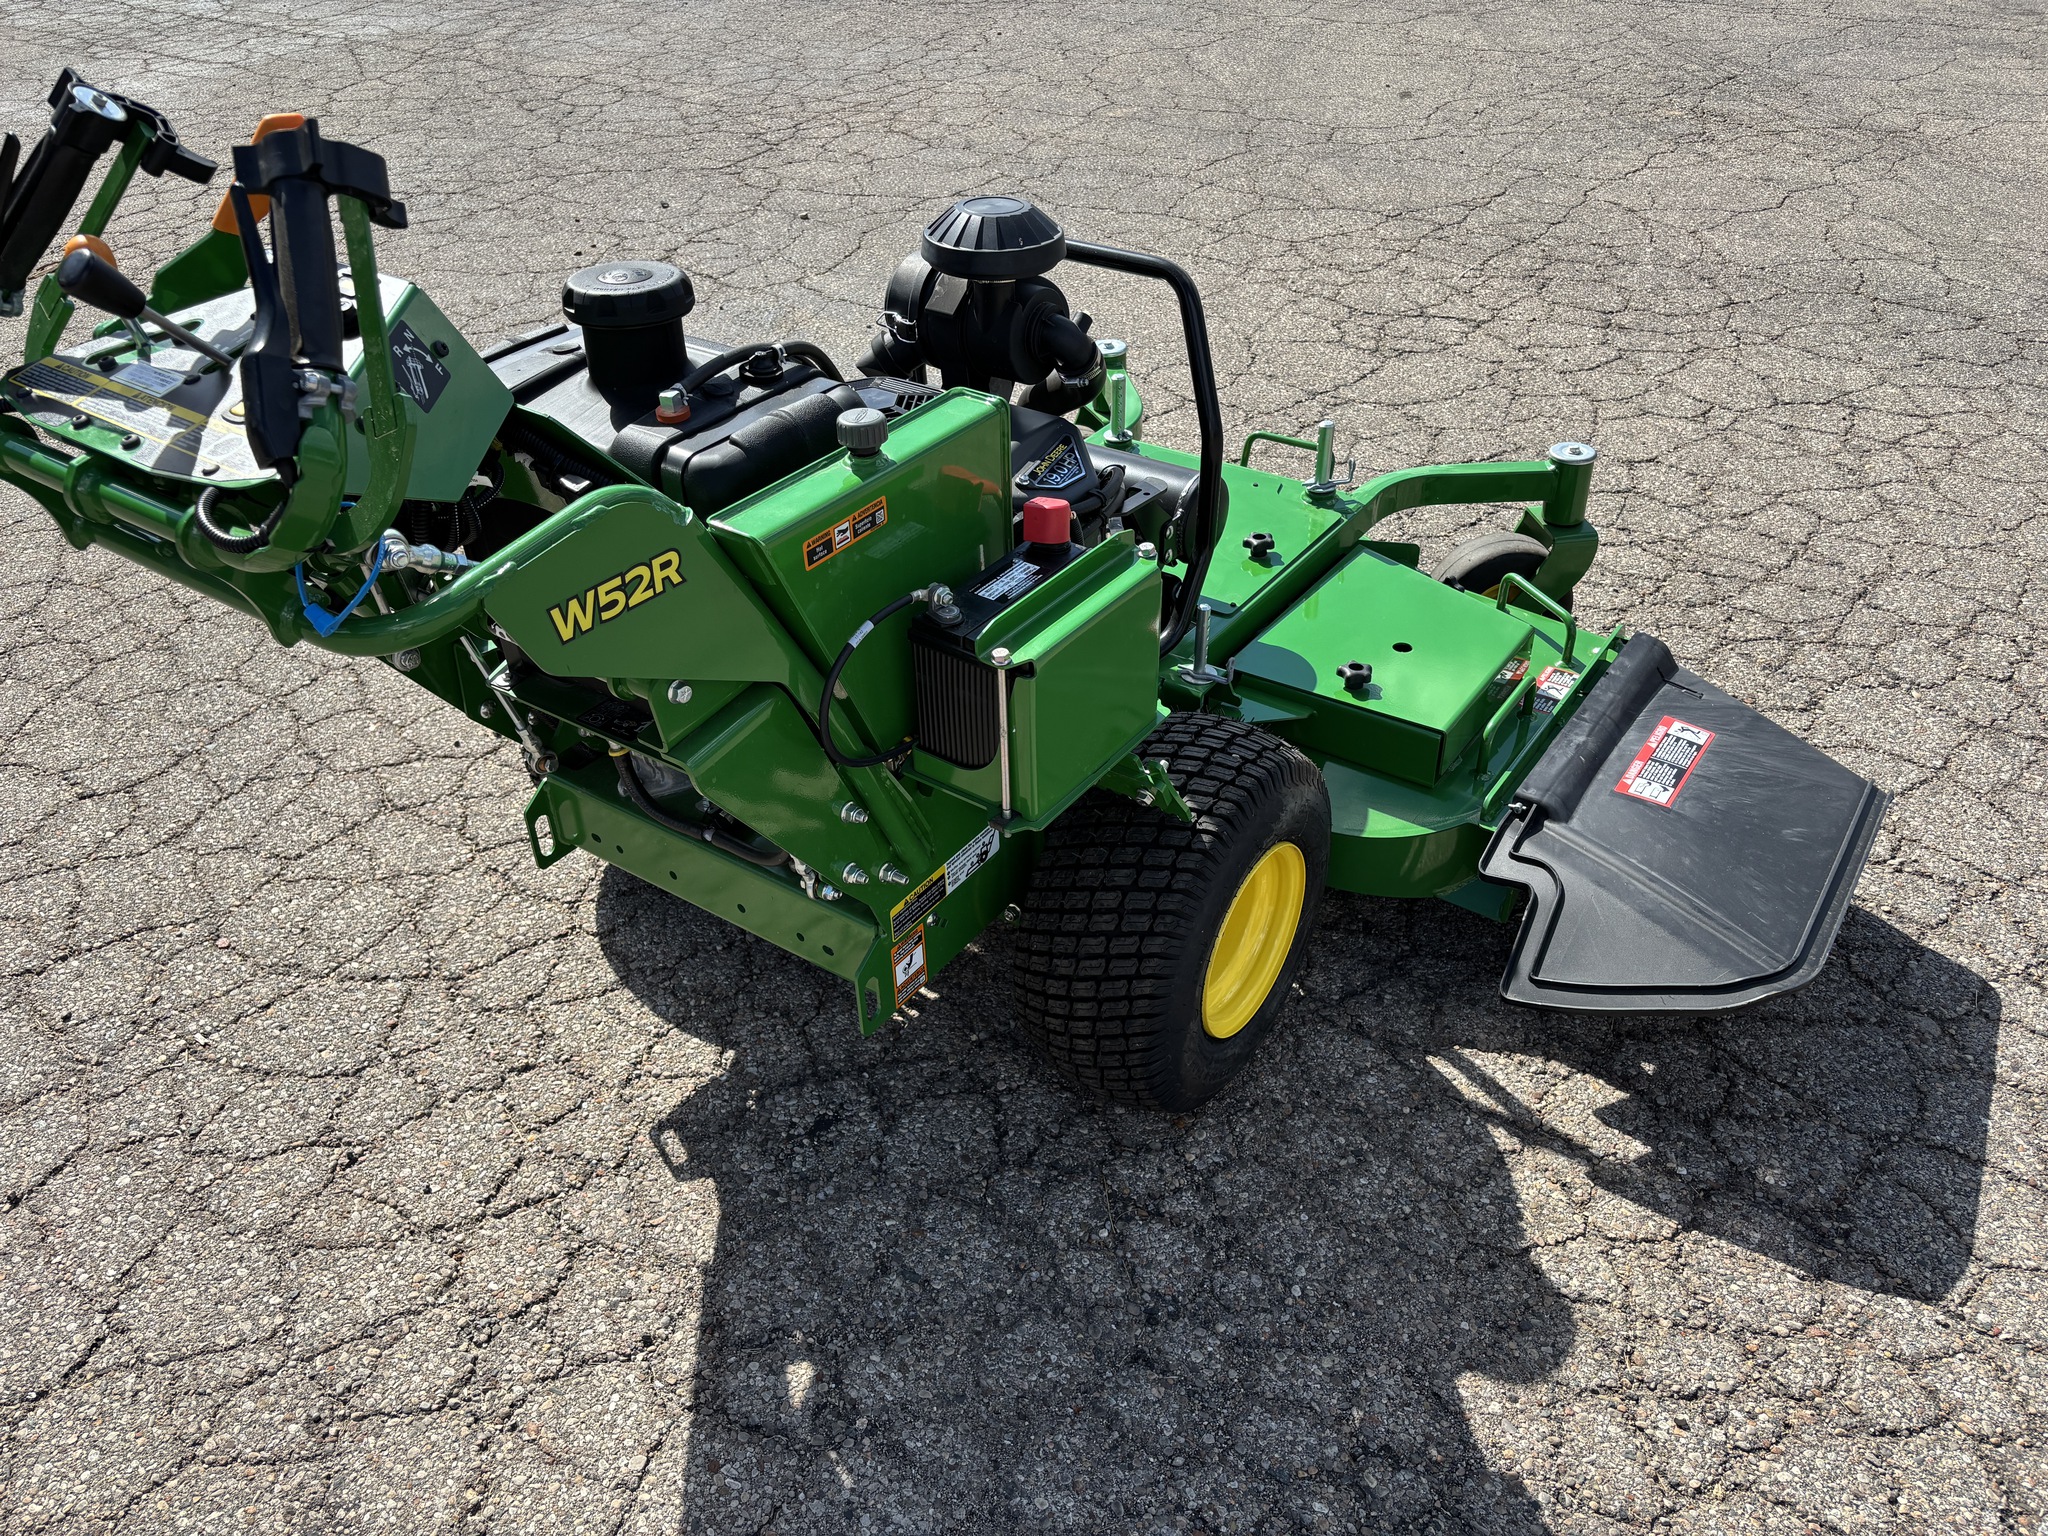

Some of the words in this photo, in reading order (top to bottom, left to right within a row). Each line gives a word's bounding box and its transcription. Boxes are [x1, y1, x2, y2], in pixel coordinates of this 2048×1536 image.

[403, 328, 415, 342] N
[392, 345, 404, 358] R
[61, 363, 91, 380] CAUTION
[434, 362, 444, 376] F
[1033, 459, 1052, 476] JOHN
[1045, 443, 1068, 462] DEERE
[811, 529, 831, 546] WARNING
[548, 549, 685, 644] W52R
[908, 876, 934, 902] CAUTION
